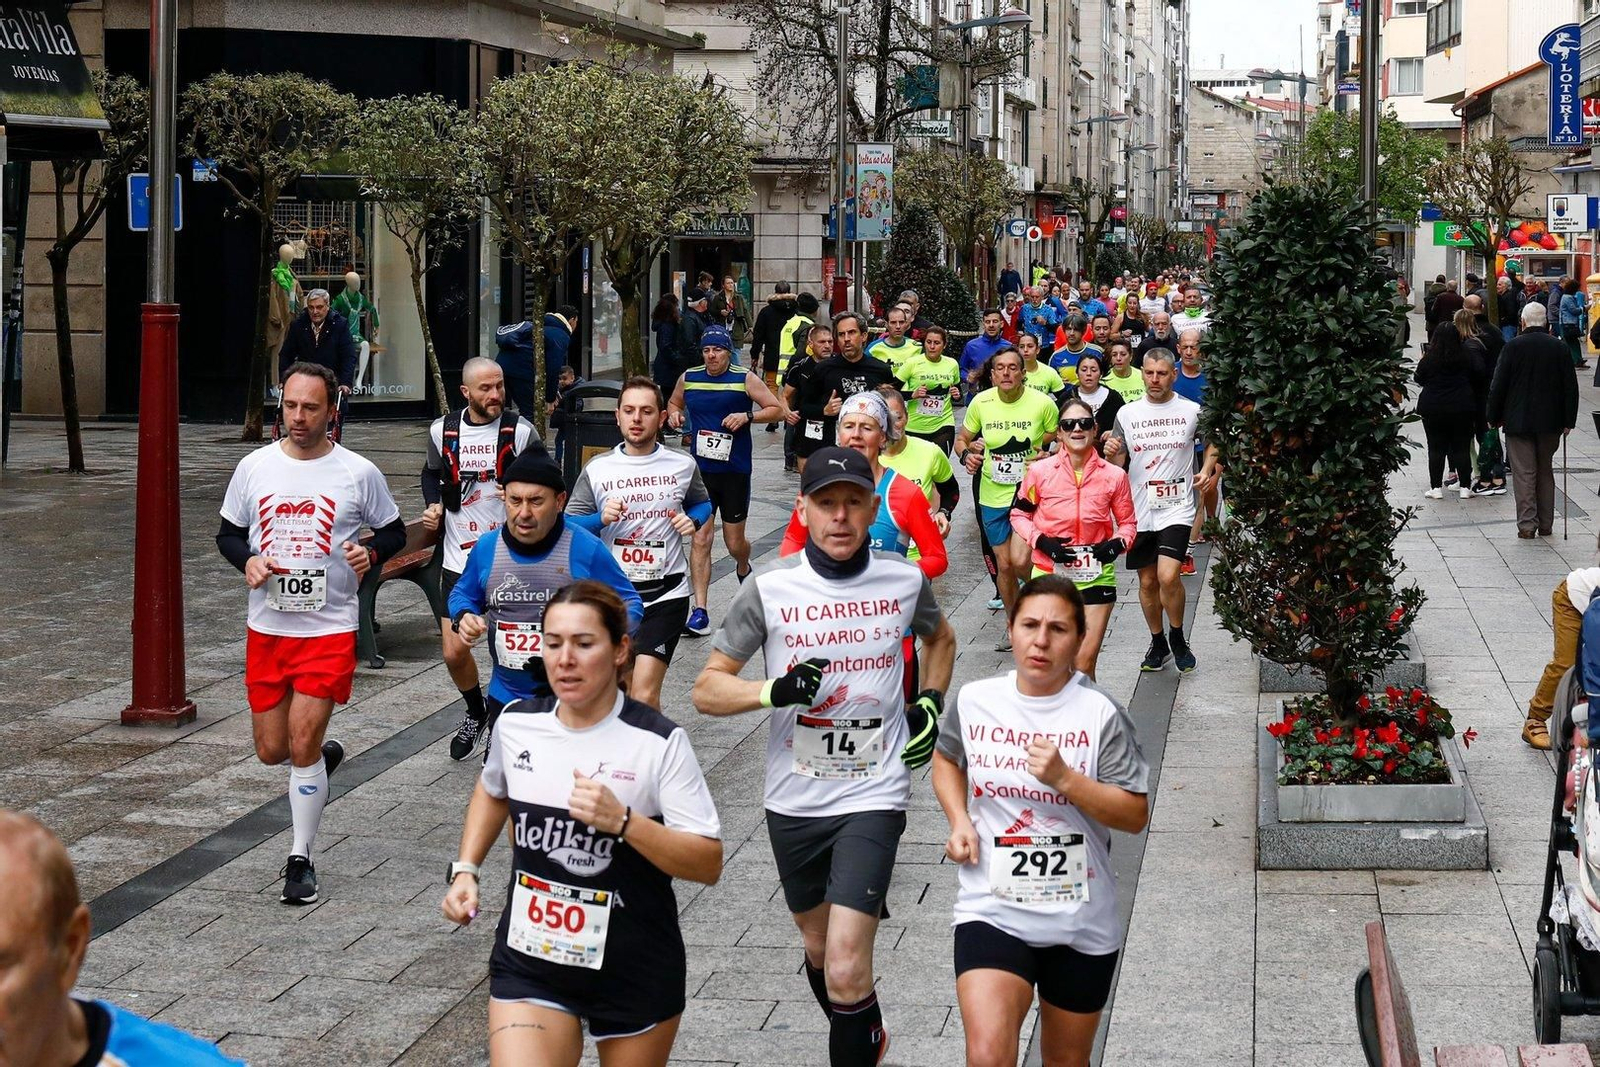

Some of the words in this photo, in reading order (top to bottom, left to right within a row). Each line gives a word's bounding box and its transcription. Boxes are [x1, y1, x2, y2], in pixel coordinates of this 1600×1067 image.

[11, 65, 60, 83] JOYERÍAS
[1559, 63, 1574, 136] LOTERÍA
[1567, 134, 1578, 142] 10
[686, 217, 751, 231] ARMACIA
[349, 383, 416, 395] shion.com
[922, 398, 940, 408] 629
[1011, 420, 1032, 430] auga
[1131, 421, 1140, 429] VI
[1141, 417, 1187, 428] CARREIRA
[706, 437, 721, 449] 57
[1132, 430, 1168, 440] CALVARIO
[1142, 440, 1186, 452] Santander
[996, 461, 1010, 472] 42
[601, 479, 614, 492] VI
[616, 475, 678, 489] CARREIRA
[1156, 485, 1178, 497] 511
[621, 548, 655, 565] 604
[277, 577, 313, 595] 108
[780, 607, 799, 623] VI
[806, 598, 902, 622] CARREIRA
[504, 633, 541, 652] 522
[784, 628, 866, 648] CALVARIO
[821, 653, 896, 674] antander
[969, 724, 985, 742] VI
[821, 731, 856, 756] 14
[968, 753, 1027, 772] CALVAR
[514, 812, 616, 858] delikia
[567, 853, 596, 868] fresh
[1010, 850, 1068, 877] 292
[527, 895, 587, 934] 650
